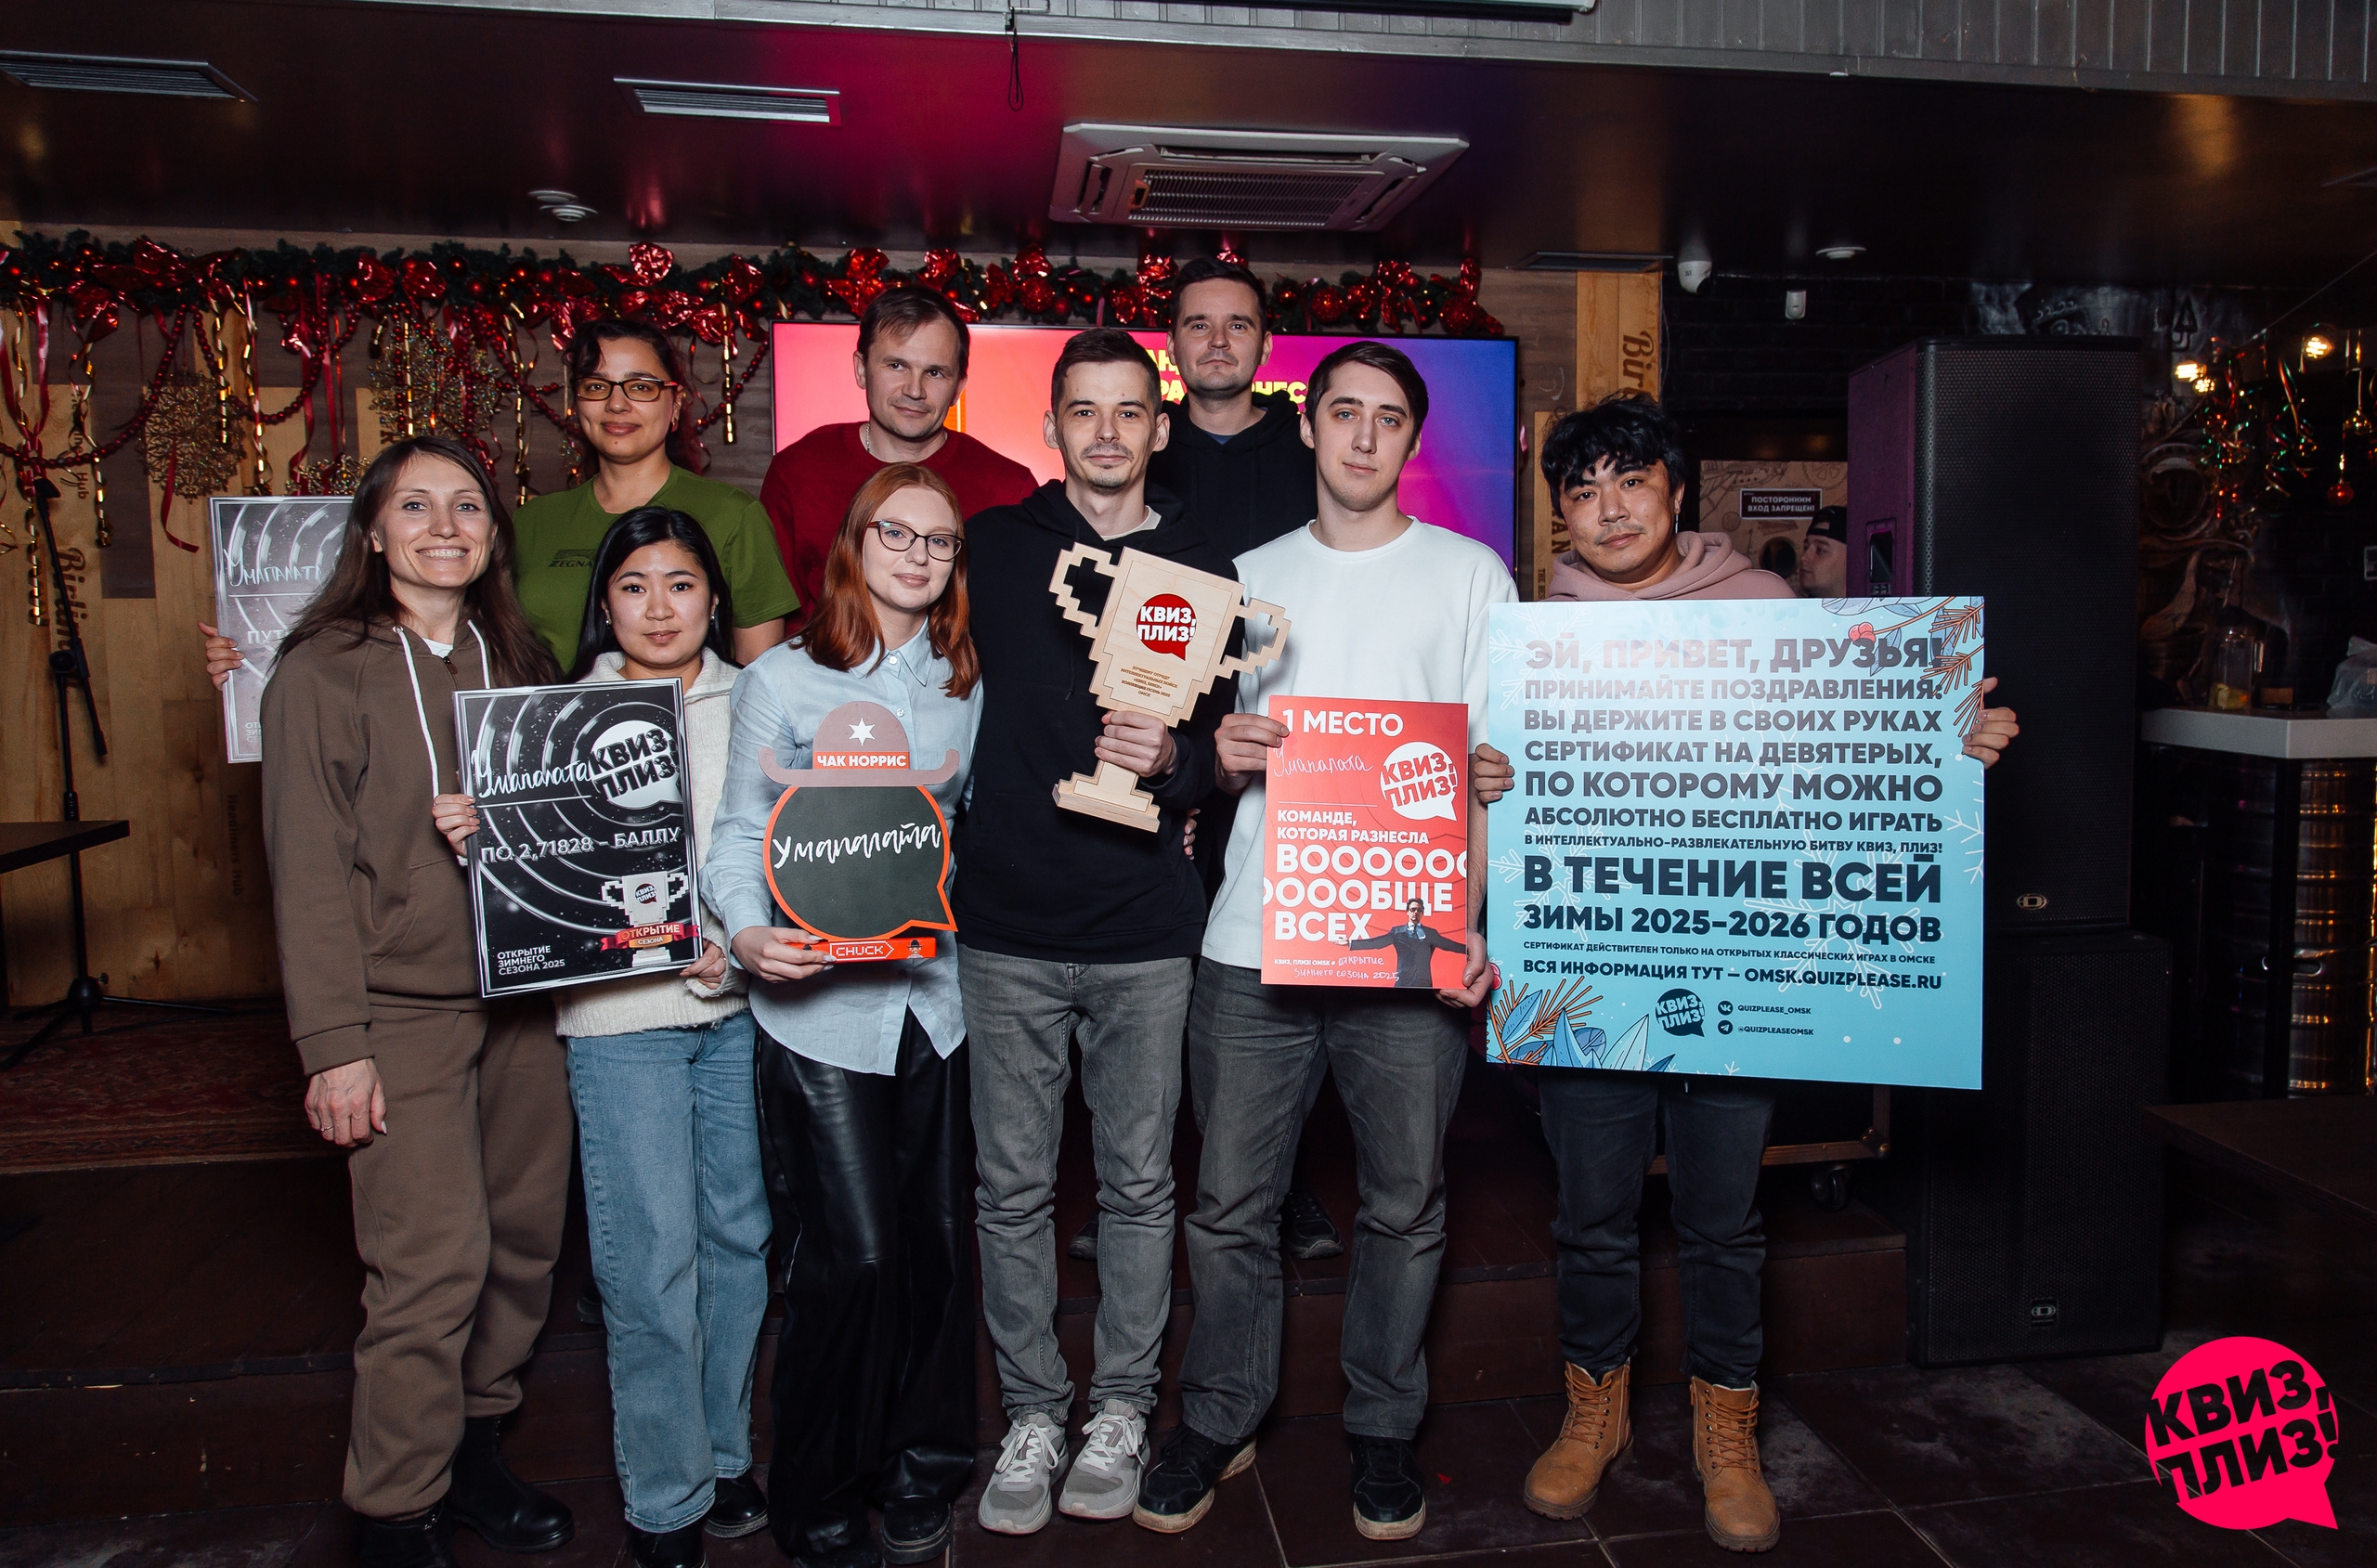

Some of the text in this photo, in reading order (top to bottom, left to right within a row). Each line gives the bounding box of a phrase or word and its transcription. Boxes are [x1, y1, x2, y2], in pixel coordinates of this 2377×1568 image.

[1140, 606, 1197, 627] КВИЗ,
[1137, 624, 1196, 642] ПЛИЗ!
[1526, 632, 1943, 674] ЭЙ, ПРИВЕТ, ДРУЗЬЯ!
[1525, 674, 1942, 703] ПРИНИМАЙТЕ ПОЗДРАВЛЕНИЯ:
[1282, 708, 1404, 736] 1 МЕСТО
[1524, 709, 1942, 733] ВЫ ДЕРЖИТЕ В СВОИХ РУКАХ
[817, 755, 907, 767] ЧАК НОРРИС
[1525, 741, 1942, 769] СЕРТИФИКАТ НА ДЕВЯТЕРЫХ,
[1382, 752, 1457, 785] КВИЗ,
[1383, 773, 1458, 809] ПЛИЗ!
[1526, 771, 1943, 802] ПО КОТОРОМУ МОЖНО
[1277, 810, 1357, 827] КОМАНДЕ,
[1525, 807, 1942, 832] АБСОЛЮТНО БЕСПЛАТНО ИГРАТЬ
[480, 846, 514, 864] ПО
[519, 836, 595, 862] 2,71828
[614, 826, 682, 850] БАЛЛУ
[1277, 827, 1430, 845] КОТОРАЯ РАЗНЕСЛА
[1525, 835, 1532, 845] В
[1810, 840, 1854, 851] БИТВУ
[1857, 841, 1897, 854] КВИЗ,
[1901, 842, 1942, 853] ПЛИЗ!
[1524, 854, 1942, 903] В ТЕЧЕНИЕ ВСЕЙ
[621, 925, 680, 940] ОТКРЫТИЕ
[1275, 910, 1372, 941] ВСЕХ
[1523, 904, 1942, 945] ЗИМЫ 2025-2026 ГОДОВ
[637, 936, 664, 945] СЕЗОНА
[836, 945, 884, 956] CHUCK
[497, 945, 552, 960] ОТКРЫТИЕ
[498, 954, 545, 968] ЗИМНЕГО
[1523, 941, 1584, 951] СЕРТИФИКАТ
[1586, 942, 1658, 953] ДЕЙСТВИТЕЛЕН
[1660, 946, 1698, 955] ТОЛЬКО
[1701, 947, 1714, 956] НА
[1716, 948, 1772, 958] ОТКРЫТЫХ
[1773, 950, 1854, 961] КЛАССИЧЕСКИХ
[1857, 953, 1888, 962] ИГРАХ
[1899, 954, 1935, 964] ОМСКЕ
[499, 959, 565, 976] СЕЗОНА 2025
[1372, 971, 1399, 981] 2025
[1523, 959, 1557, 973] ВСЯ
[1560, 960, 1687, 979] ИНФОРМАЦИЯ
[1691, 965, 1723, 980] ТУТ
[1744, 967, 1942, 989] OMSK.QUIZPLEASE.RU
[1656, 994, 1704, 1016] КВИЗ,
[1737, 1004, 1812, 1015] QUIZPLEASE_OMSK
[1657, 1008, 1705, 1030] ПЛИЗ!
[1738, 1026, 1813, 1035] @QUIZPLEASEOMSK
